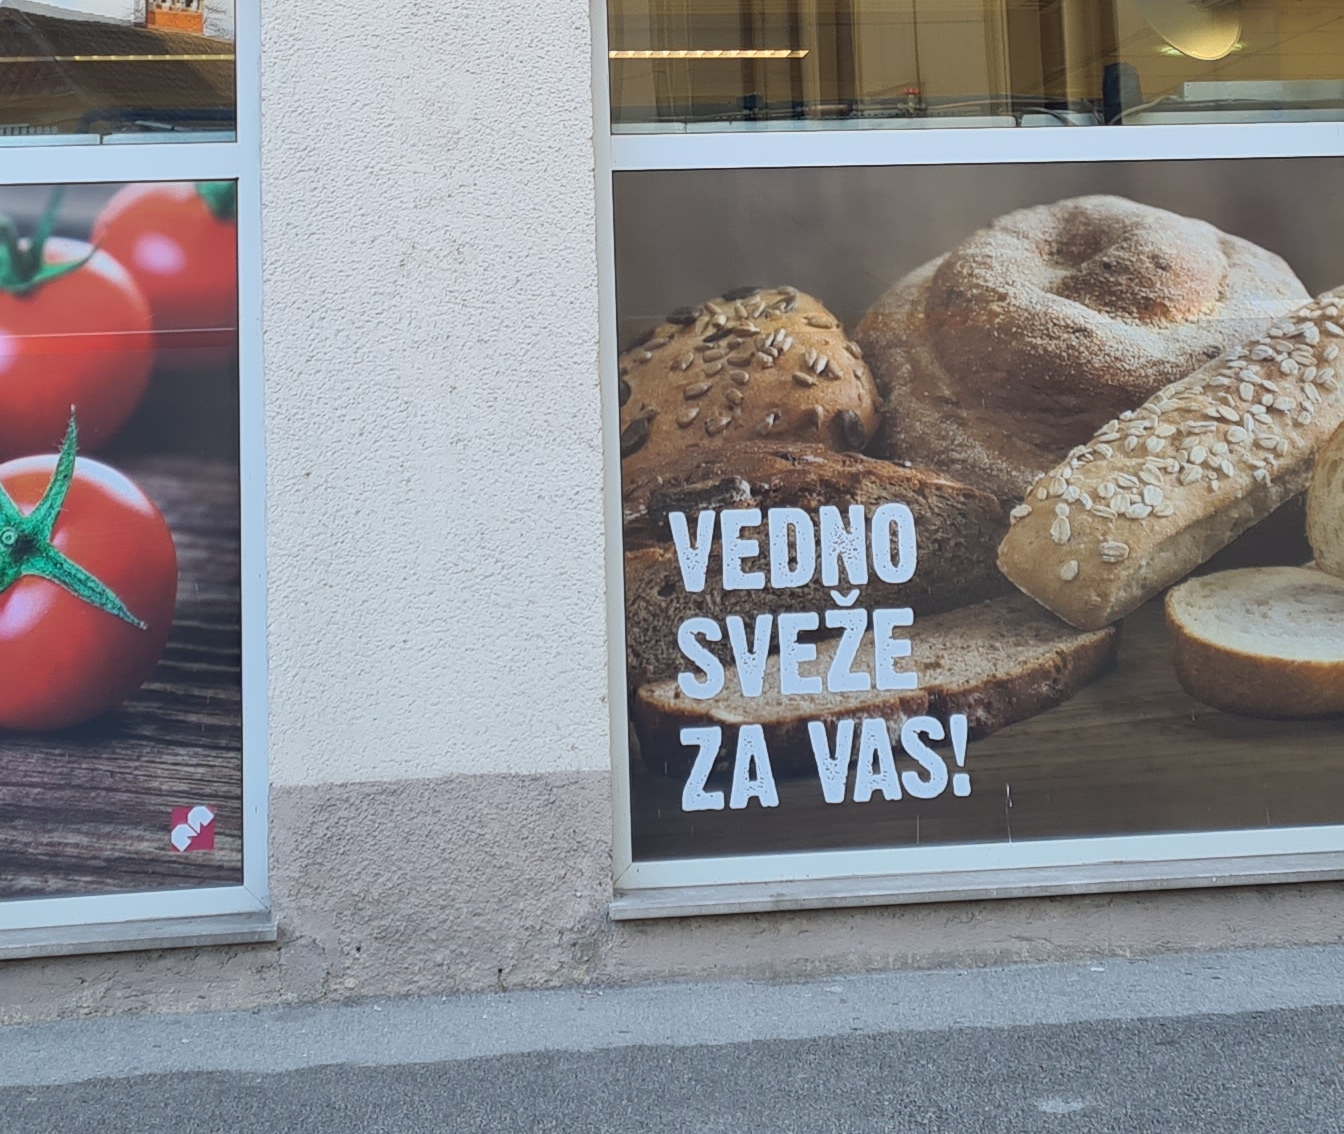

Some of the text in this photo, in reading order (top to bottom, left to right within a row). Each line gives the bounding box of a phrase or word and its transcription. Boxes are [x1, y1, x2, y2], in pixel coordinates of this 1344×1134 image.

[668, 503, 918, 592] VEDNO
[676, 589, 919, 700] SVEŽE
[680, 714, 972, 812] ZA VAS!
